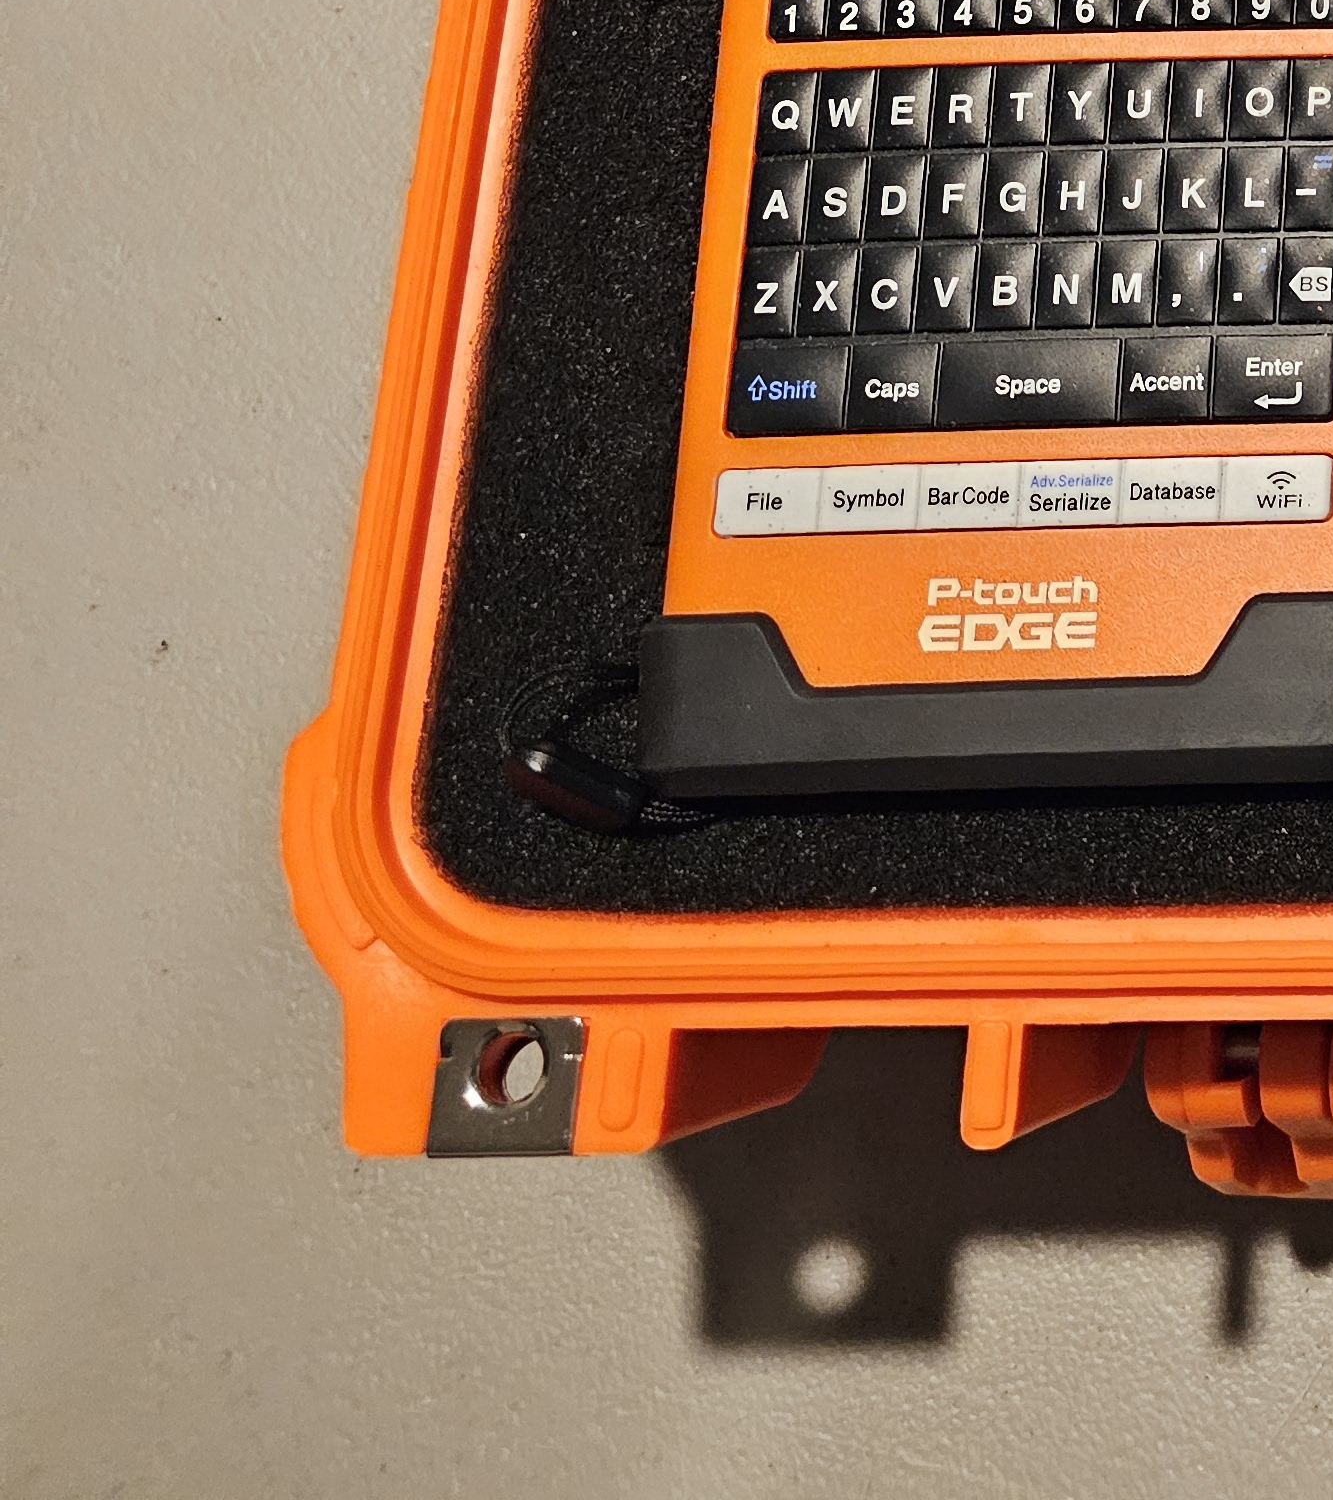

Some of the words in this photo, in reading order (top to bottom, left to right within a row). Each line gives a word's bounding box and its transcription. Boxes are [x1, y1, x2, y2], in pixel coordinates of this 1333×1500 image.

[784, 4, 797, 32] 1
[840, 2, 859, 30] 2
[896, 0, 915, 28] 3
[771, 100, 799, 130] Q
[828, 98, 862, 128] W
[891, 96, 916, 126] E
[949, 94, 974, 124] R
[1010, 92, 1033, 122] T
[1068, 90, 1092, 120] Y
[1126, 89, 1152, 119] U
[1195, 88, 1204, 118] I
[1245, 87, 1274, 117] O
[1307, 86, 1332, 117] P
[762, 190, 789, 219] A
[823, 187, 848, 218] S
[880, 186, 906, 216] D
[942, 184, 965, 214] F
[999, 182, 1027, 212] G
[1059, 180, 1086, 210] H
[1122, 179, 1142, 209] J
[1181, 178, 1207, 208] K
[1244, 178, 1265, 208] L
[754, 283, 779, 314] Z
[812, 280, 839, 312] X
[871, 279, 898, 310] C
[933, 277, 959, 308] V
[992, 275, 1018, 307] B
[1052, 273, 1079, 304] N
[1111, 272, 1143, 303] M
[1300, 276, 1329, 291] BS
[1246, 356, 1303, 376] Enter
[768, 380, 817, 400] Shift
[865, 379, 920, 402] Caps
[994, 375, 1061, 396] Space
[1129, 372, 1204, 392] Accent
[746, 492, 783, 511] File
[833, 489, 905, 510] Symbol
[928, 487, 958, 505] Bar
[960, 486, 1010, 504] Code
[1029, 492, 1111, 512] Serialize
[1129, 482, 1216, 502] Database
[1256, 494, 1303, 509] WiFi
[928, 576, 1098, 605] P-touch
[918, 612, 1097, 651] EDGE
